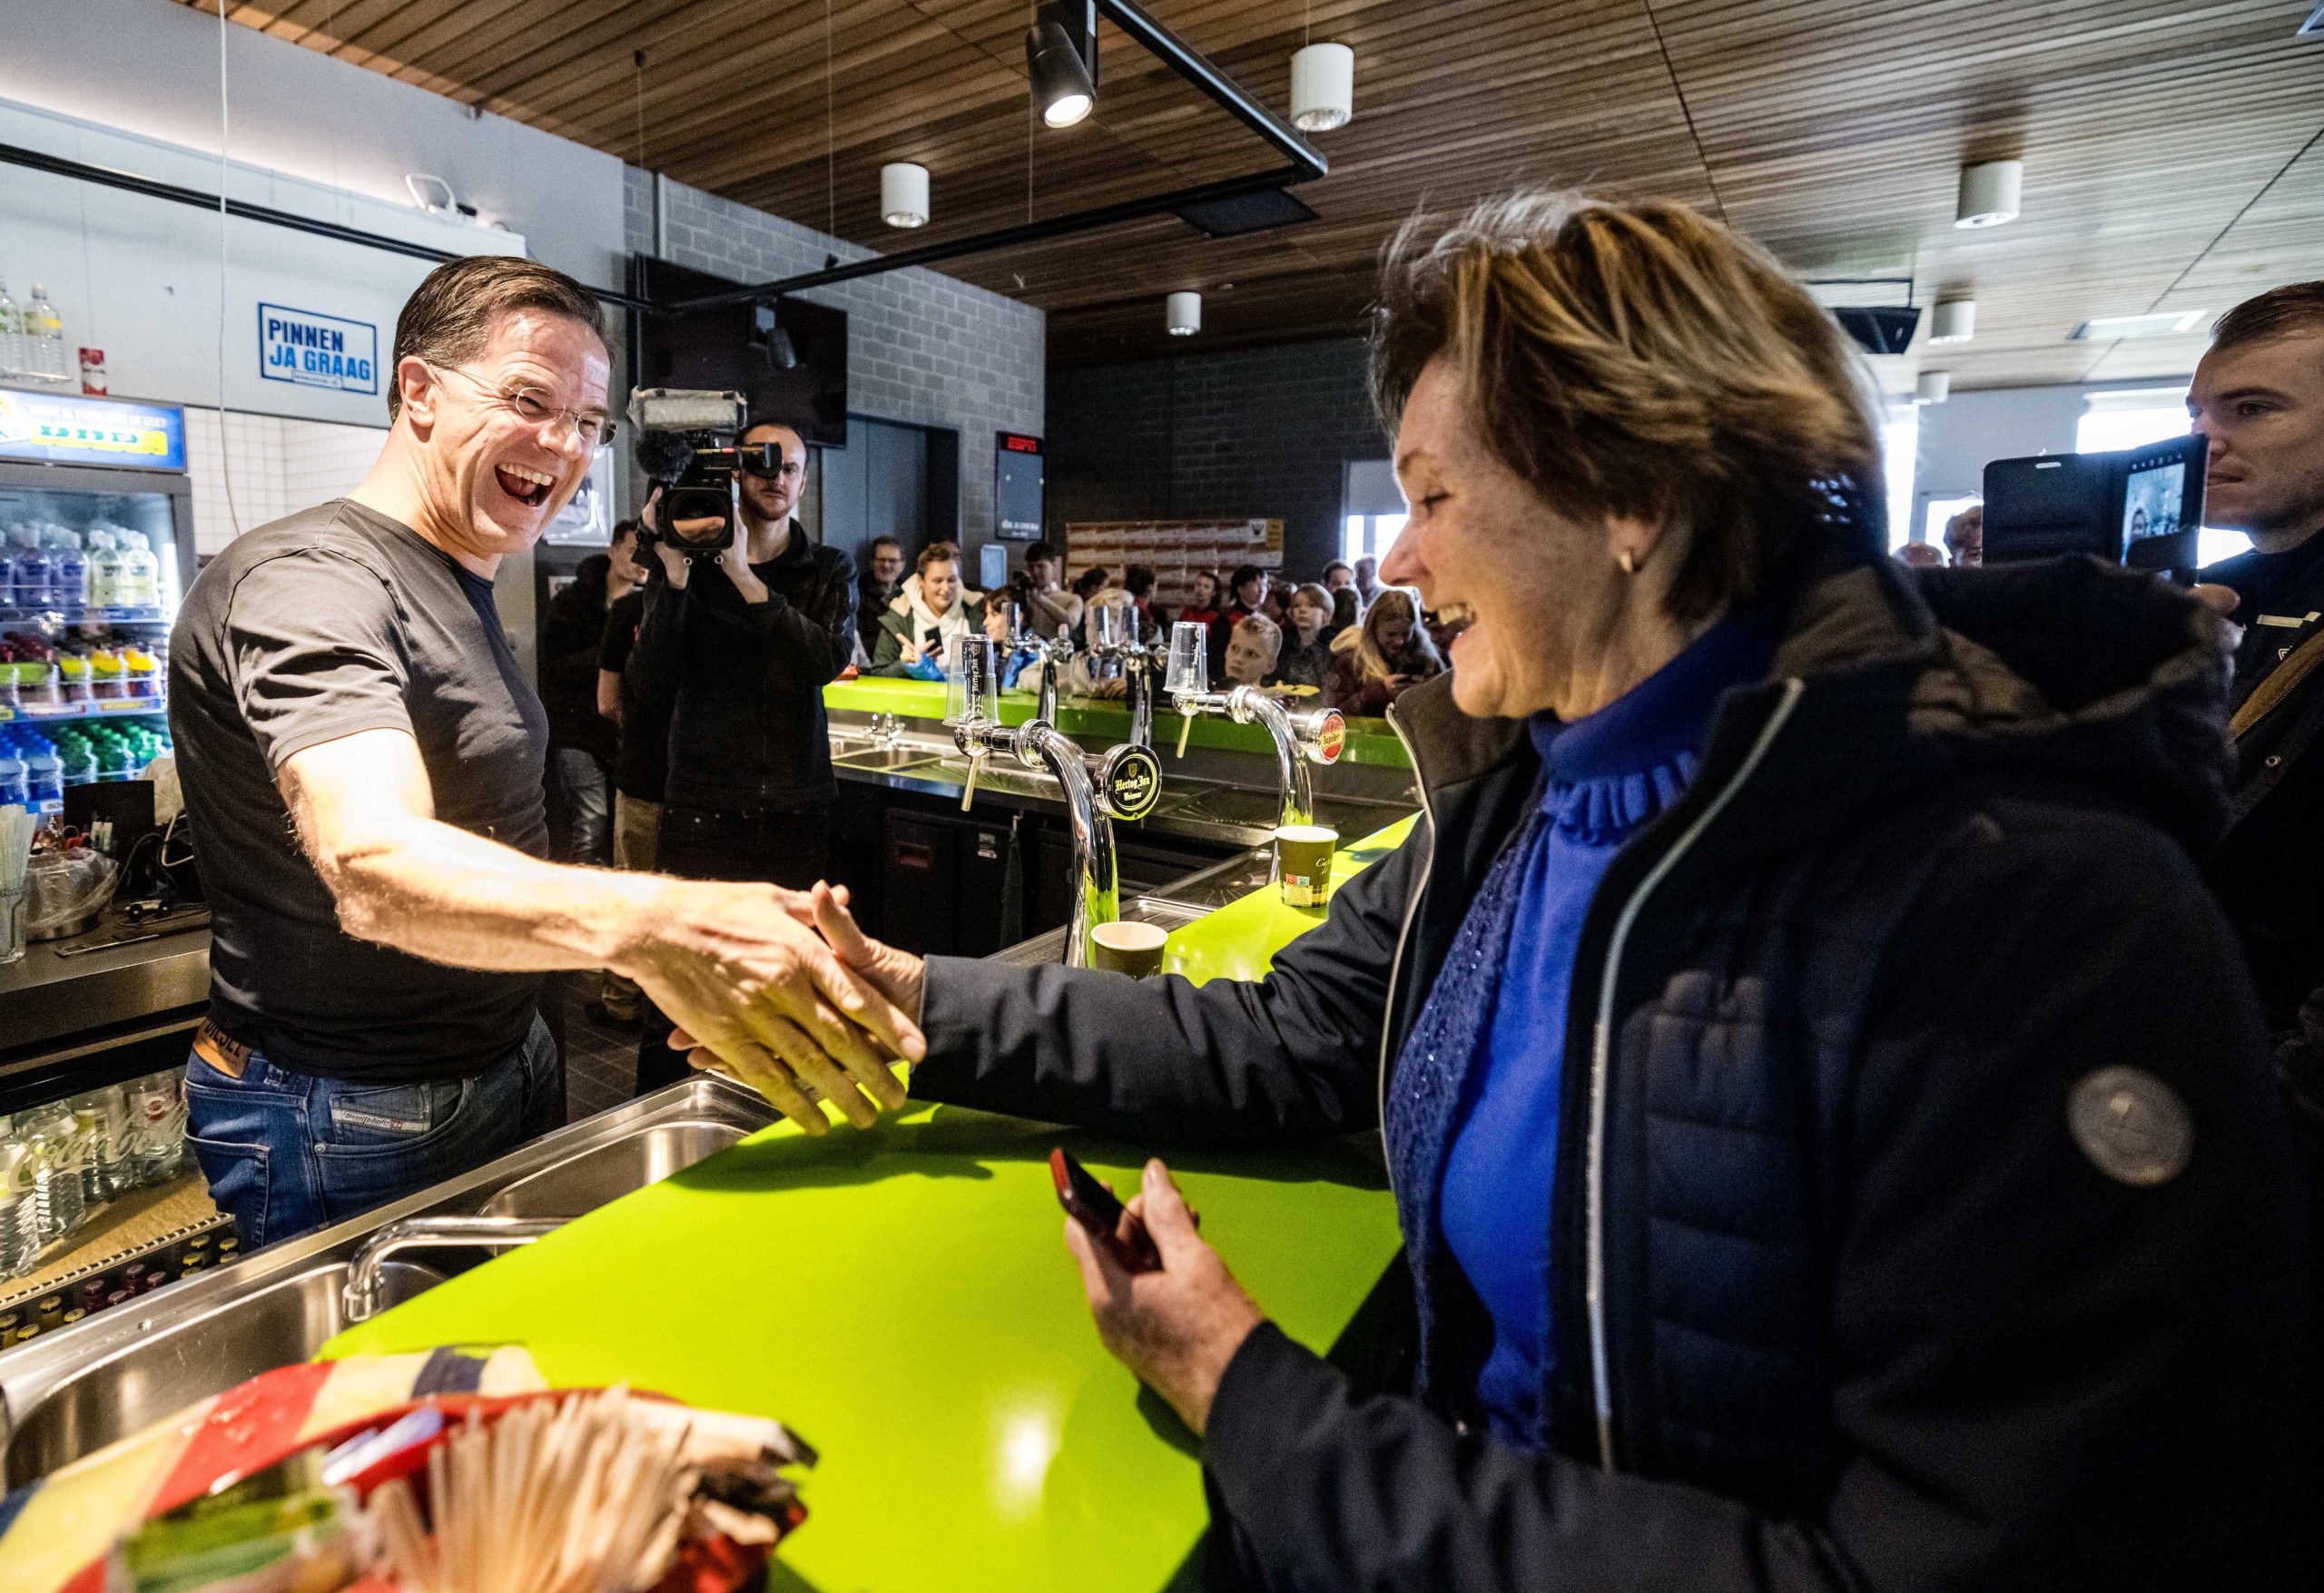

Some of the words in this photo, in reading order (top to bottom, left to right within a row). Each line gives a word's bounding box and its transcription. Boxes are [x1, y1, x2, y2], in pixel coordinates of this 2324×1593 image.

[269, 318, 344, 354] PINNEN
[269, 344, 297, 369] JA
[303, 349, 370, 381] GRAAG
[1115, 779, 1138, 794] Hertog
[1137, 775, 1151, 790] Jan
